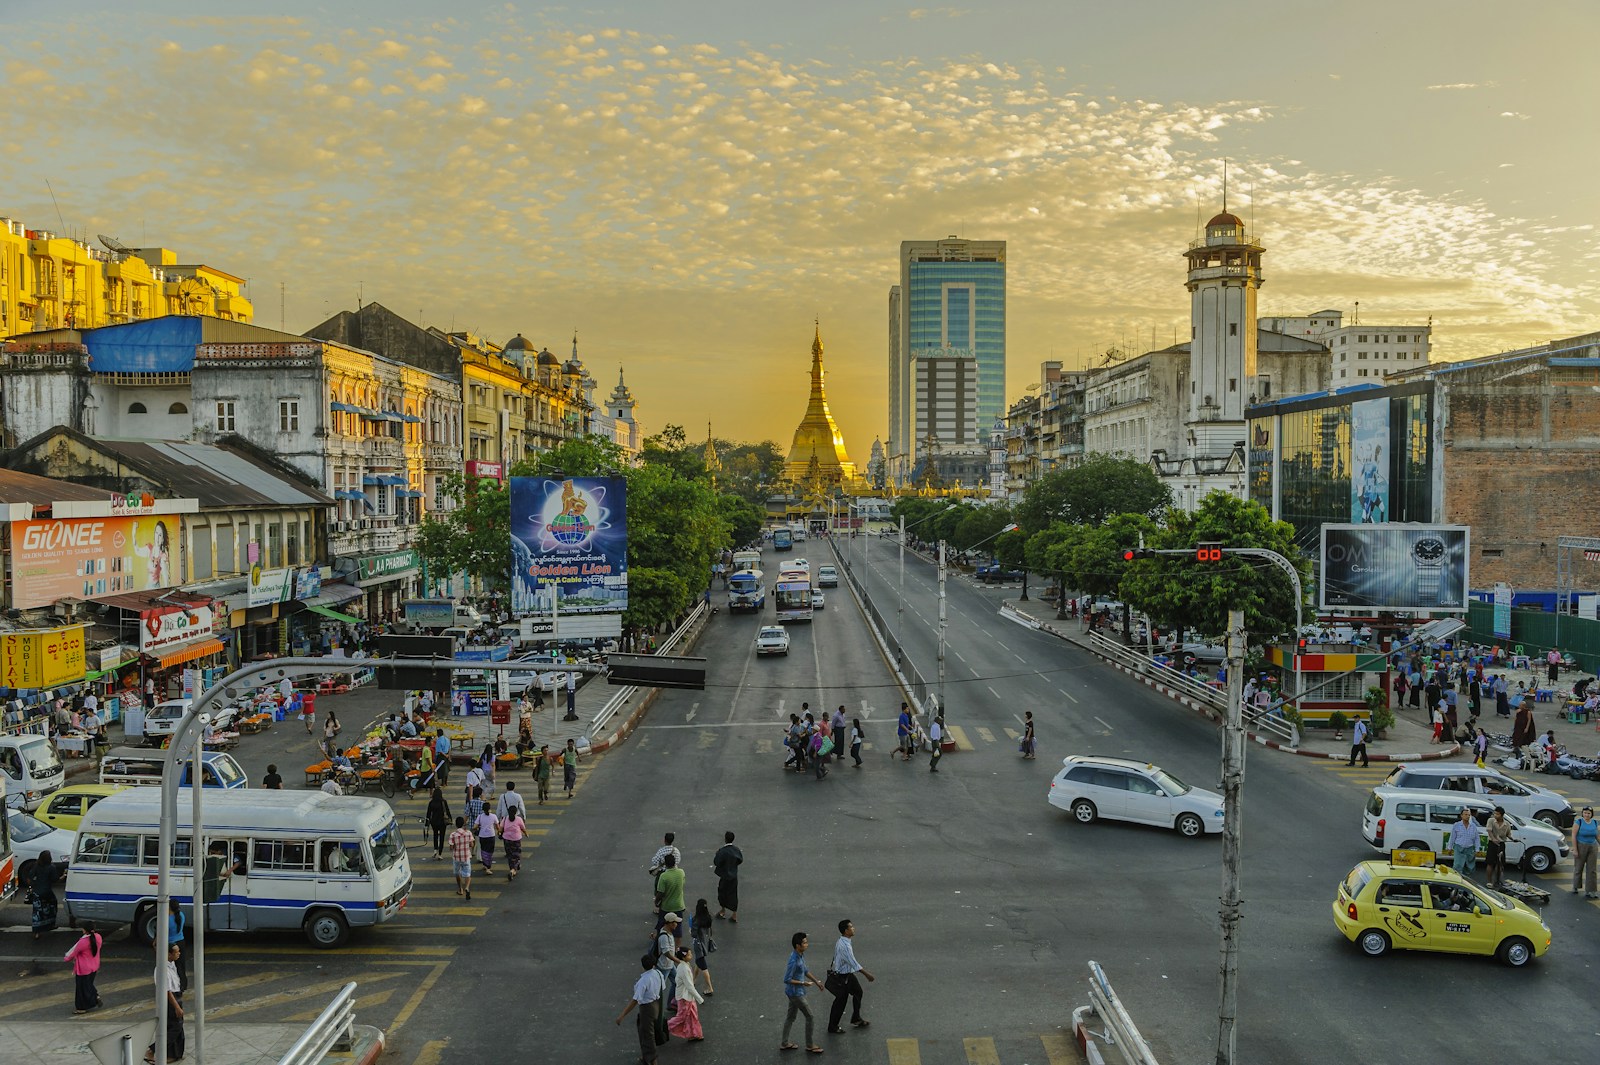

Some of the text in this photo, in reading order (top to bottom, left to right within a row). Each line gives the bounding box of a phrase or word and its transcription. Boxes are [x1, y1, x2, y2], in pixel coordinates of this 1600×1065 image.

[546, 524, 576, 533] Golden
[386, 554, 412, 569] PHARMACY
[529, 563, 611, 576] Golden Lion
[7, 635, 18, 688] SULAY
[23, 637, 31, 682] MOBILE
